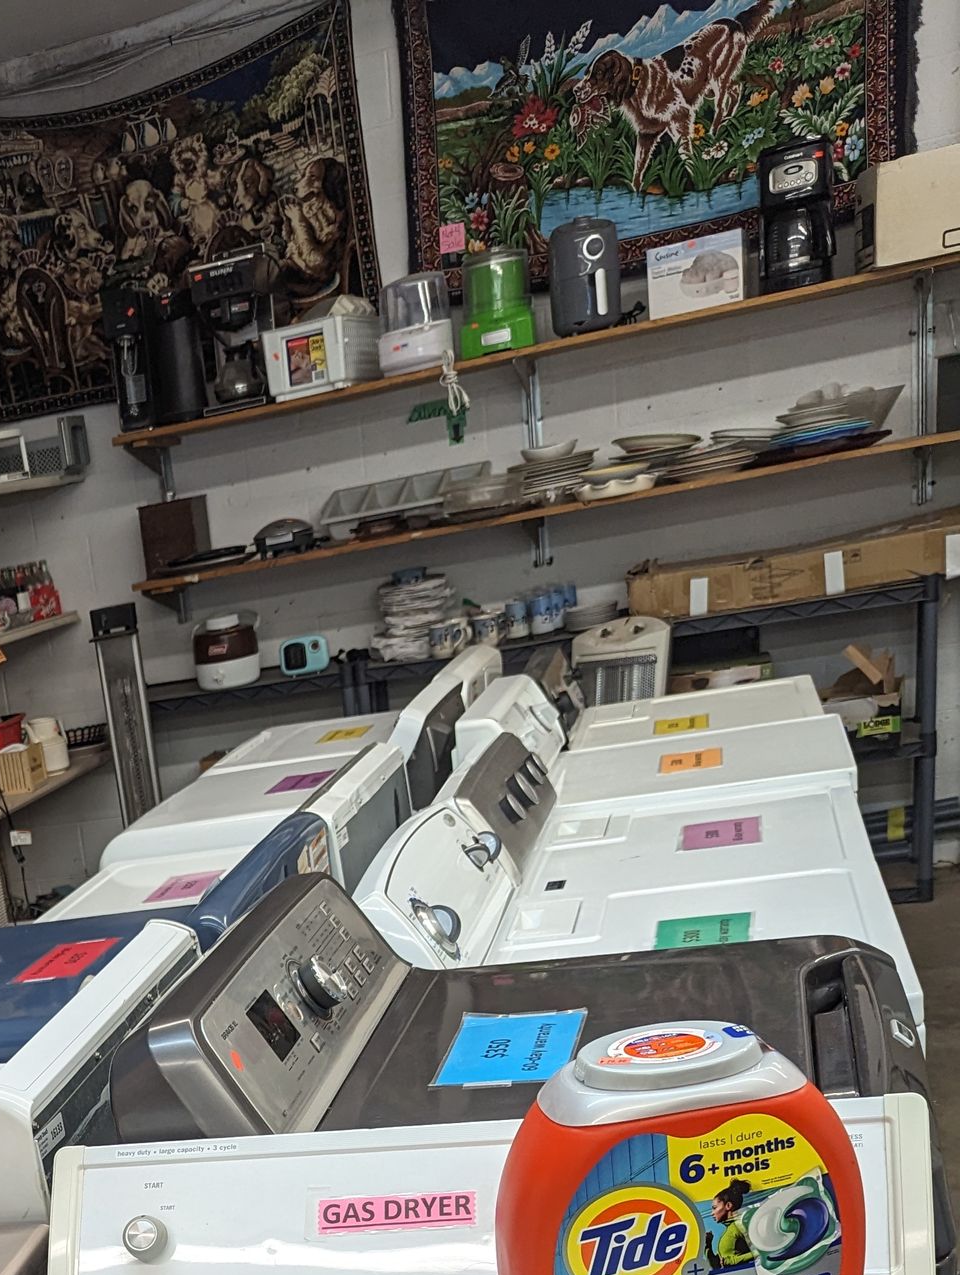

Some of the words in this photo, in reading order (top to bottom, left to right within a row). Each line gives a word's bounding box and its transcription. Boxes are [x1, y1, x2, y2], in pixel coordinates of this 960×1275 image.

[534, 1023, 557, 1050] warranty
[481, 1038, 511, 1058] $350
[699, 1137, 726, 1150] lasts
[735, 1129, 763, 1142] dure
[723, 1137, 795, 1162] months
[117, 1150, 136, 1158] heavy
[176, 1145, 205, 1154] capacity
[219, 1143, 237, 1151] cycle
[679, 1154, 720, 1184] 6+
[724, 1158, 770, 1177] mois
[144, 1182, 164, 1190] START
[321, 1200, 375, 1225] GAS
[384, 1194, 471, 1220] DRYER
